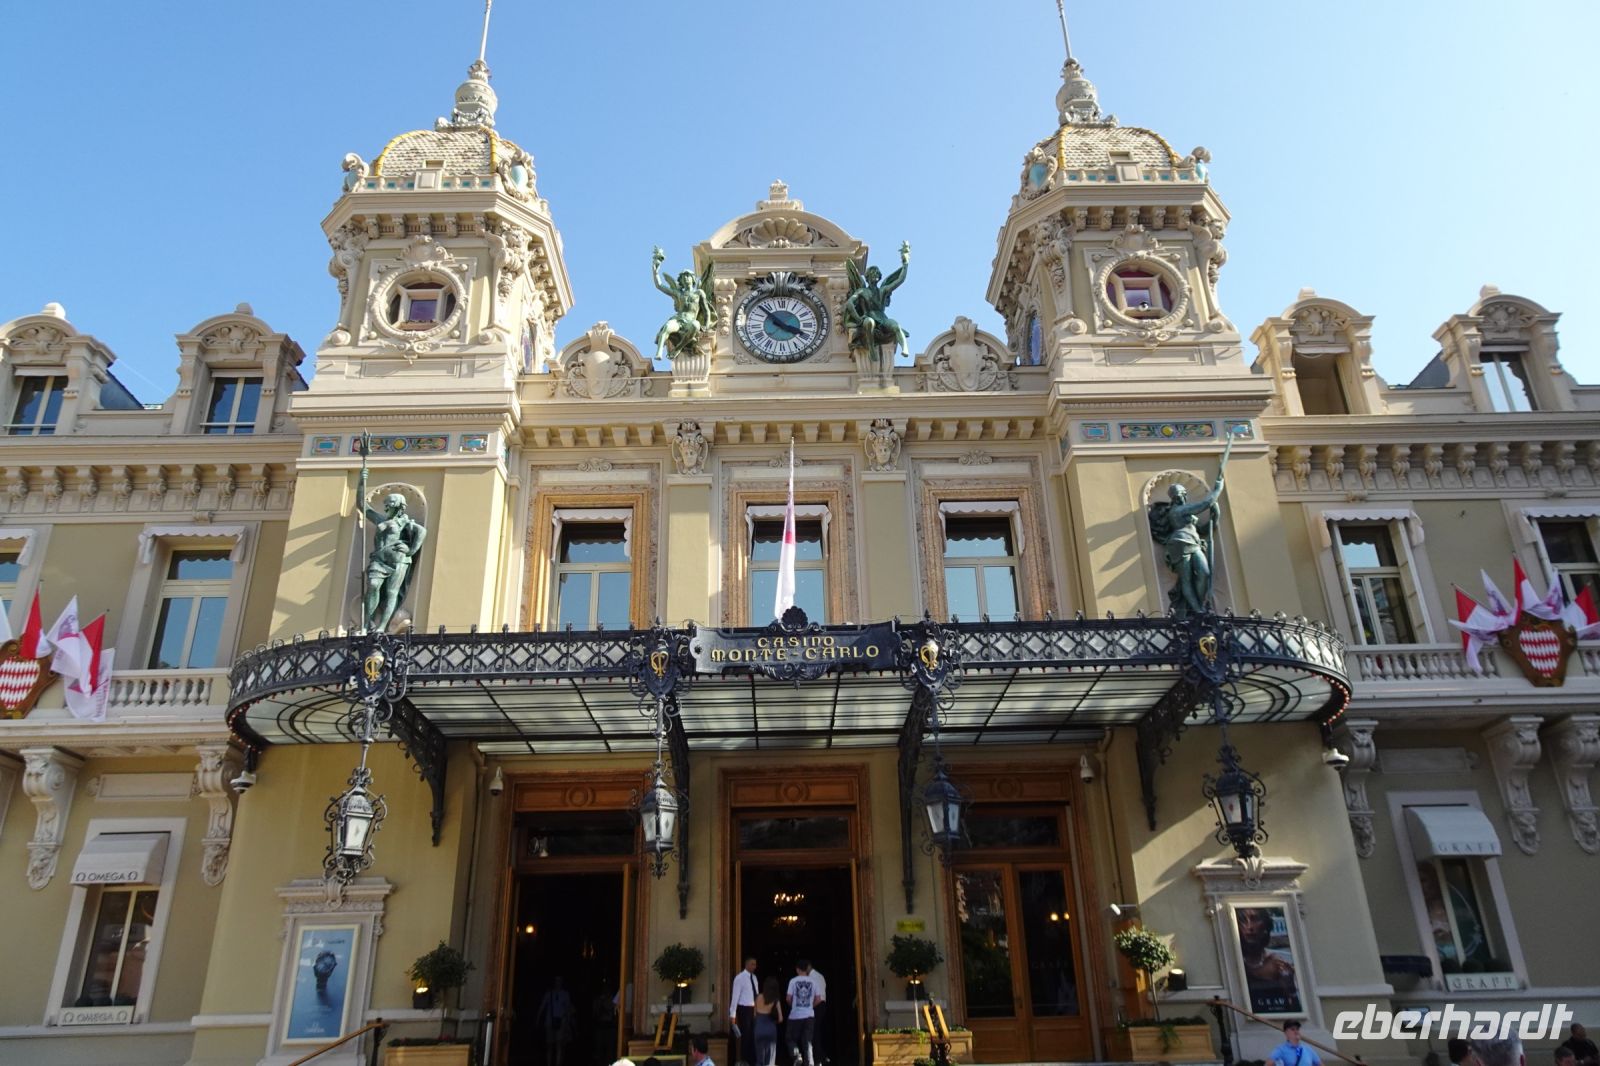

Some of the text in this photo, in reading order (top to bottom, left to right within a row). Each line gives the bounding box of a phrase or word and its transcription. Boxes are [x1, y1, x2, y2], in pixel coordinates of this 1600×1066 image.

[757, 636, 835, 648] CASINO
[87, 871, 126, 881] OMEGA
[1453, 975, 1513, 989] GRAFF
[76, 1012, 114, 1023] OMEGA
